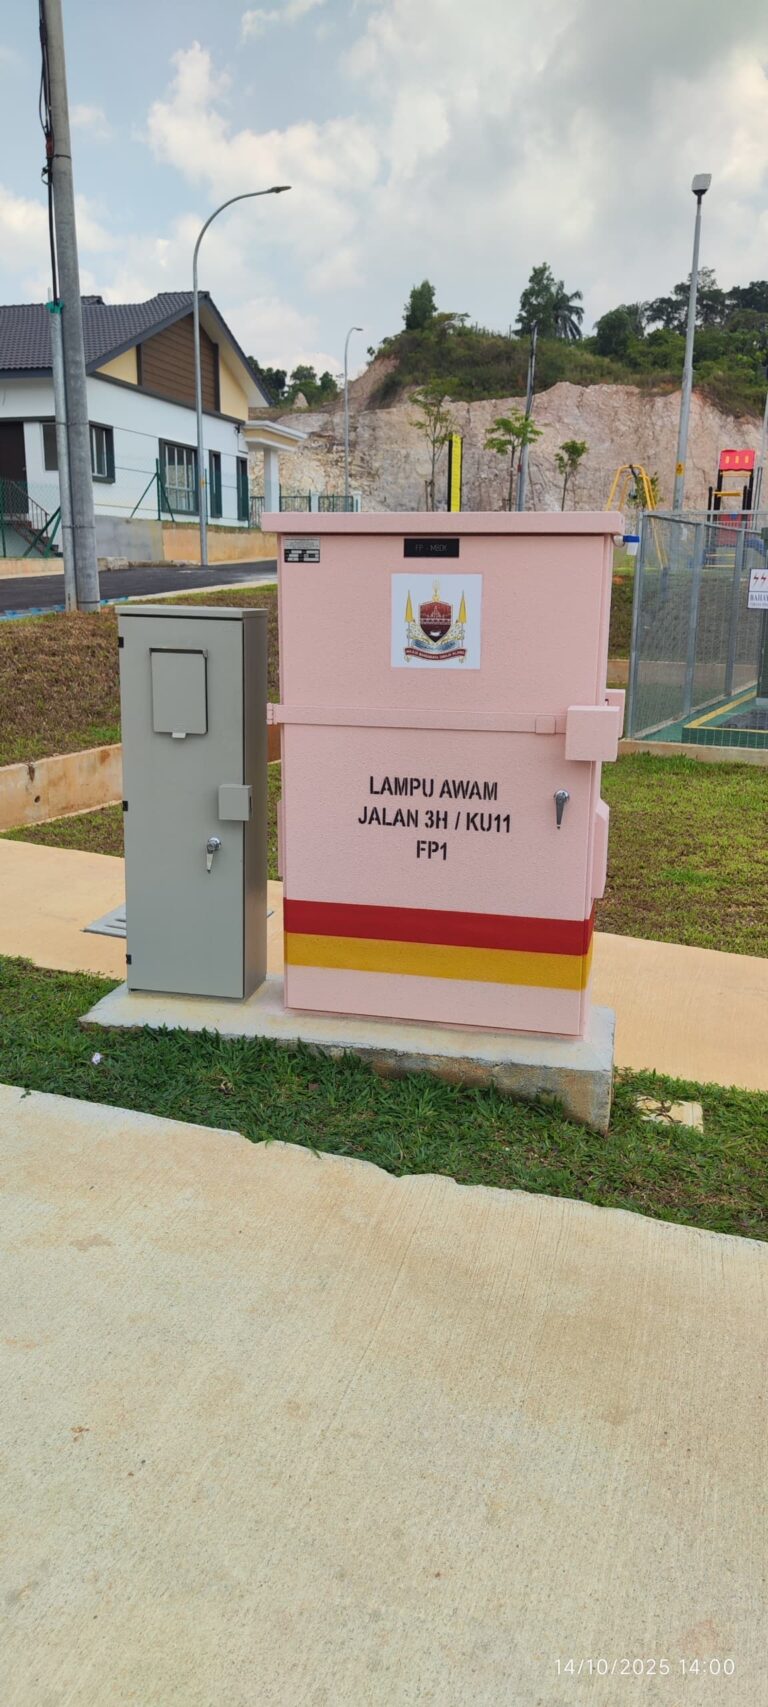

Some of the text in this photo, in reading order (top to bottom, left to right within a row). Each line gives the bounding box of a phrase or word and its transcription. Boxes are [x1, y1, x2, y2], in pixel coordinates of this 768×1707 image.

[369, 776, 498, 801] LAMPU AWAM
[357, 806, 511, 834] JALAN 3H / KU11
[416, 840, 448, 861] FP1
